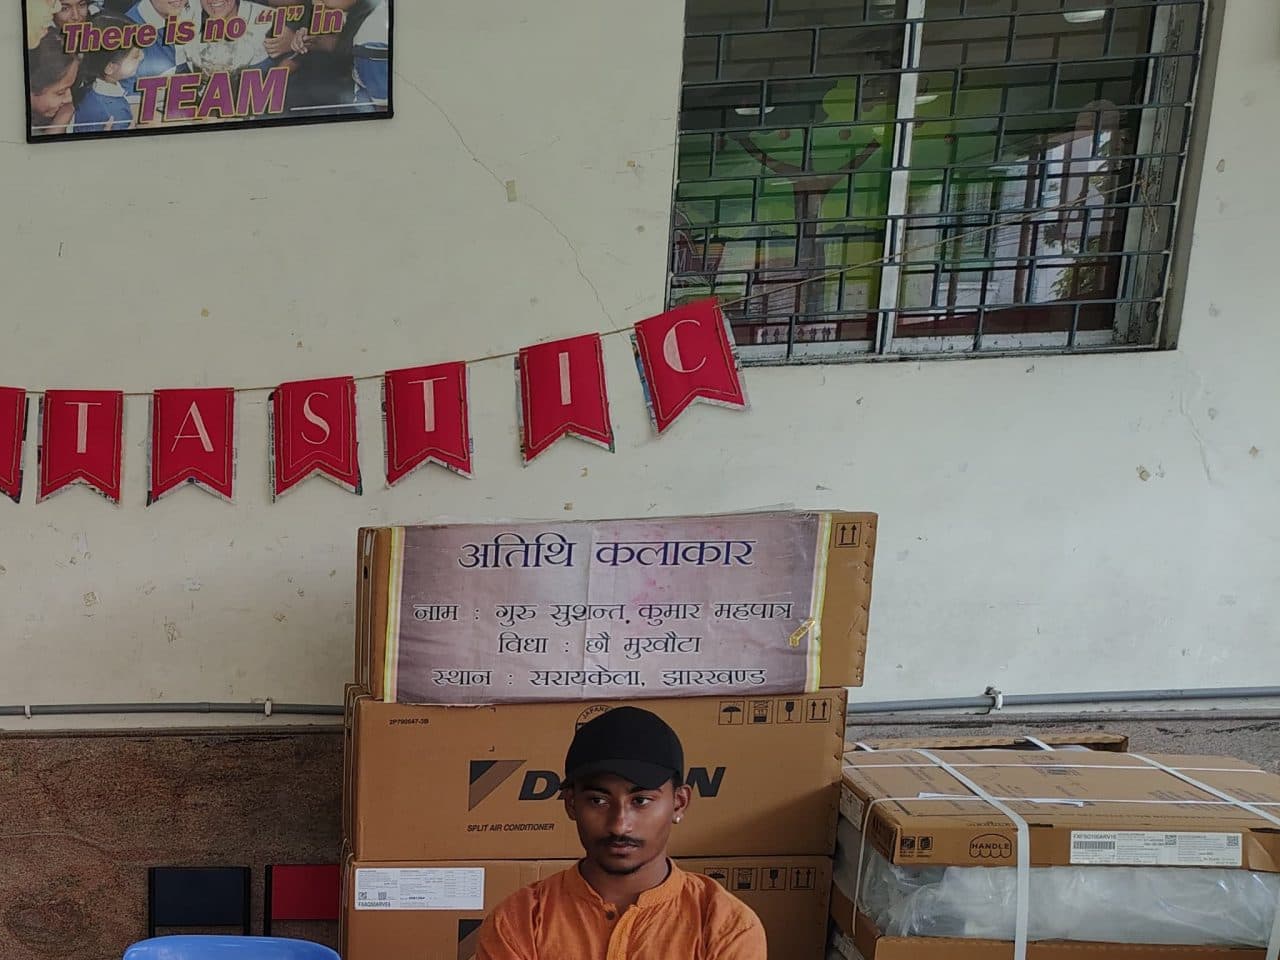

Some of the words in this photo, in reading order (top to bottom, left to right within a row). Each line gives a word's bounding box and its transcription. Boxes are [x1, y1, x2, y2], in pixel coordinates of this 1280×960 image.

[64, 22, 157, 52] There
[166, 16, 196, 44] is
[204, 17, 247, 41] no
[310, 4, 344, 36] in
[137, 67, 290, 125] TEAM
[458, 532, 577, 568] अतिथि
[596, 540, 757, 566] कलाकार
[414, 605, 460, 621] नाम
[495, 605, 538, 627] गुरु
[638, 603, 703, 626] कुमार
[498, 632, 549, 653] विधा
[624, 631, 703, 659] मुखौटा
[432, 668, 493, 685] स्थान
[662, 668, 766, 685] झारखण्ड
[467, 824, 489, 832] SPLIT
[503, 823, 555, 831] CONDITIONER
[972, 842, 1010, 850] HANDLE
